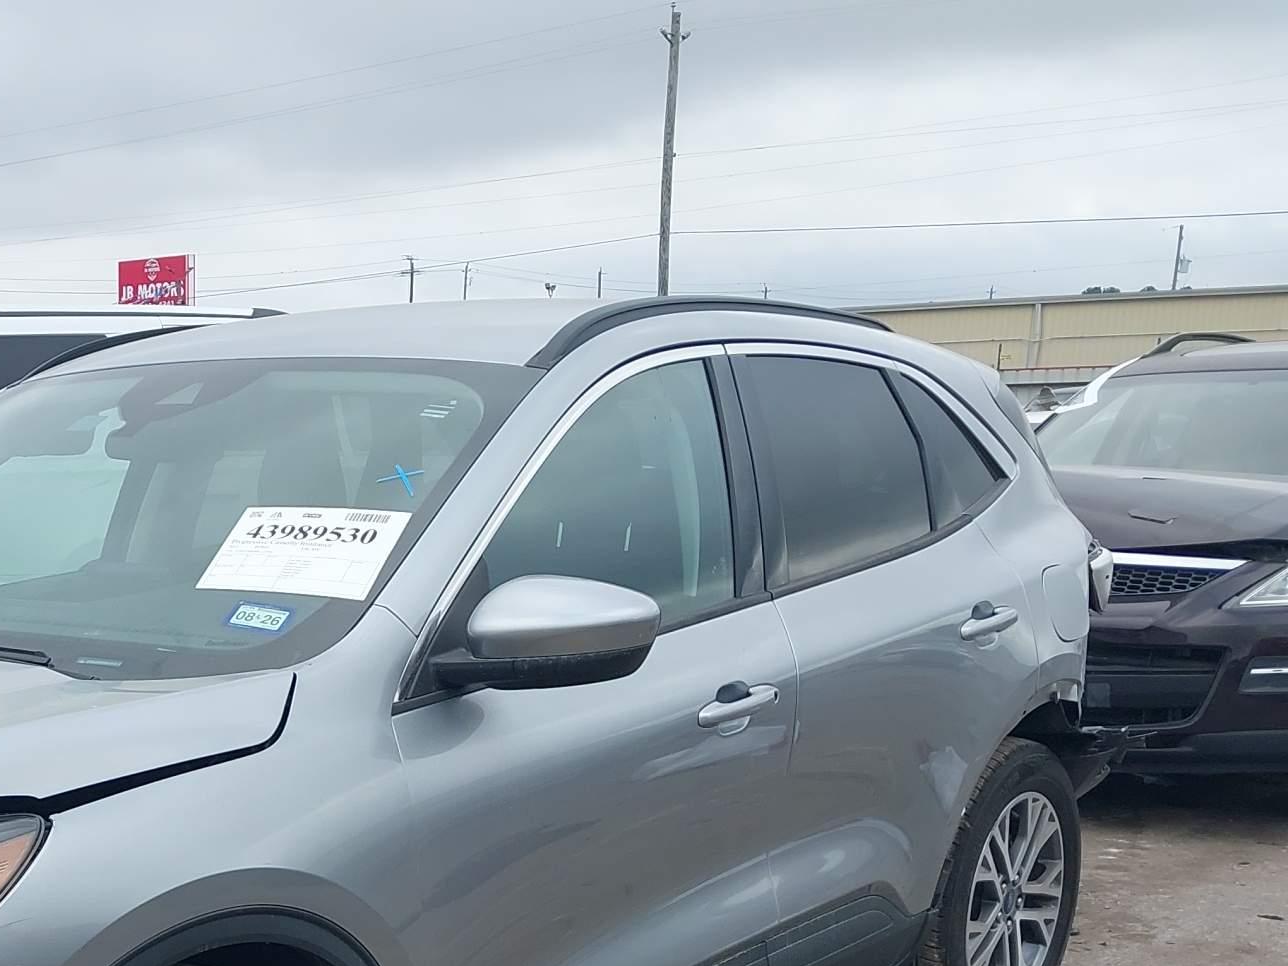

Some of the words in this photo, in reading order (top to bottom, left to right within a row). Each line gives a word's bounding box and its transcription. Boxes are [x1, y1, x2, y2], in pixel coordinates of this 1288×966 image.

[121, 285, 134, 300] JB
[246, 523, 378, 545] 43989530
[235, 610, 256, 622] 08
[259, 614, 282, 626] 26
